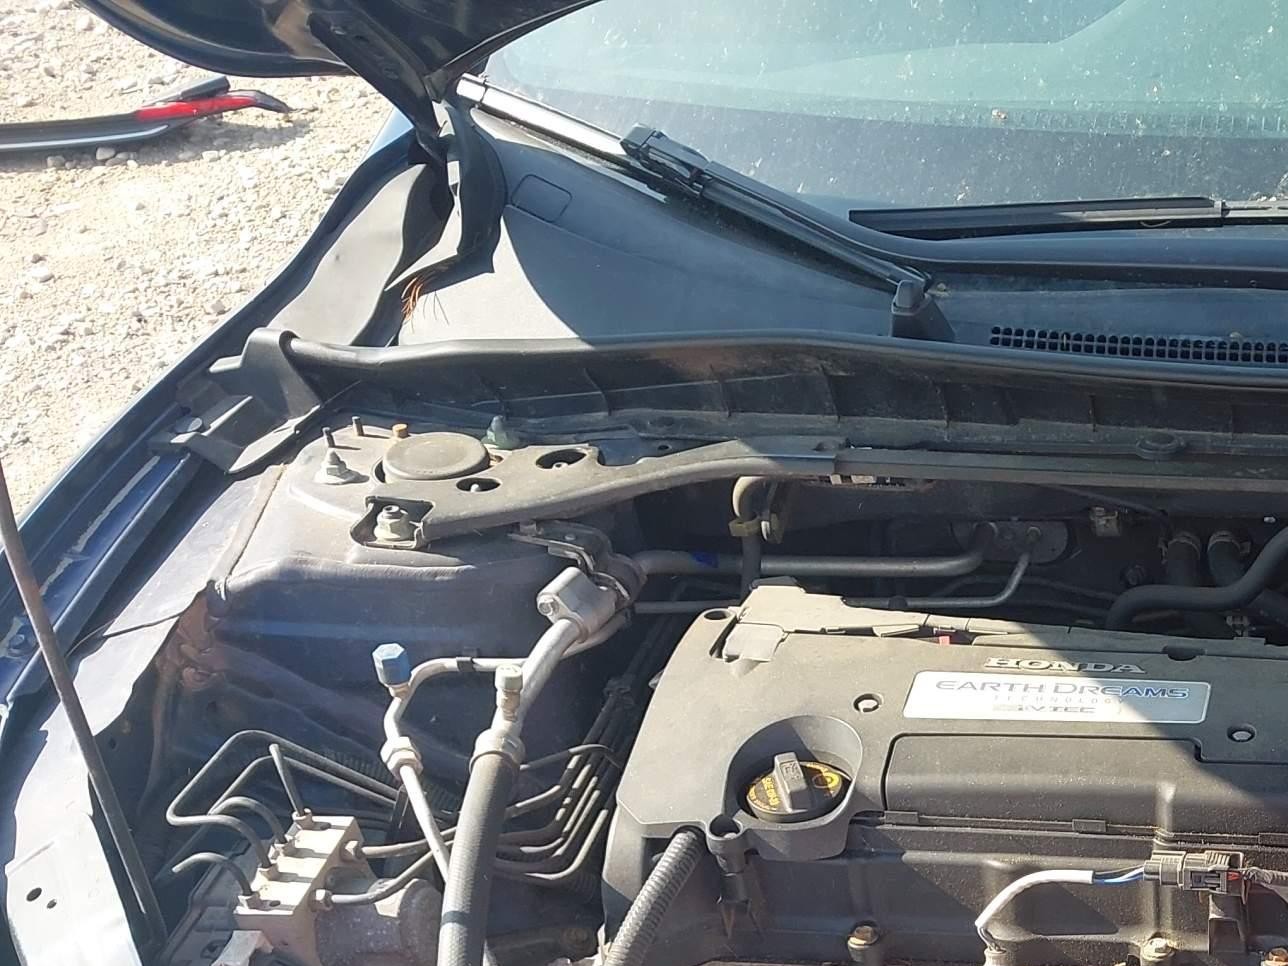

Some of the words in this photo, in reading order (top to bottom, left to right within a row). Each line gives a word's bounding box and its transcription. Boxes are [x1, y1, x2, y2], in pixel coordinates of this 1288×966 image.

[984, 657, 1145, 674] HONDA
[936, 681, 1044, 693] EARTH
[1053, 682, 1189, 698] DREAMS
